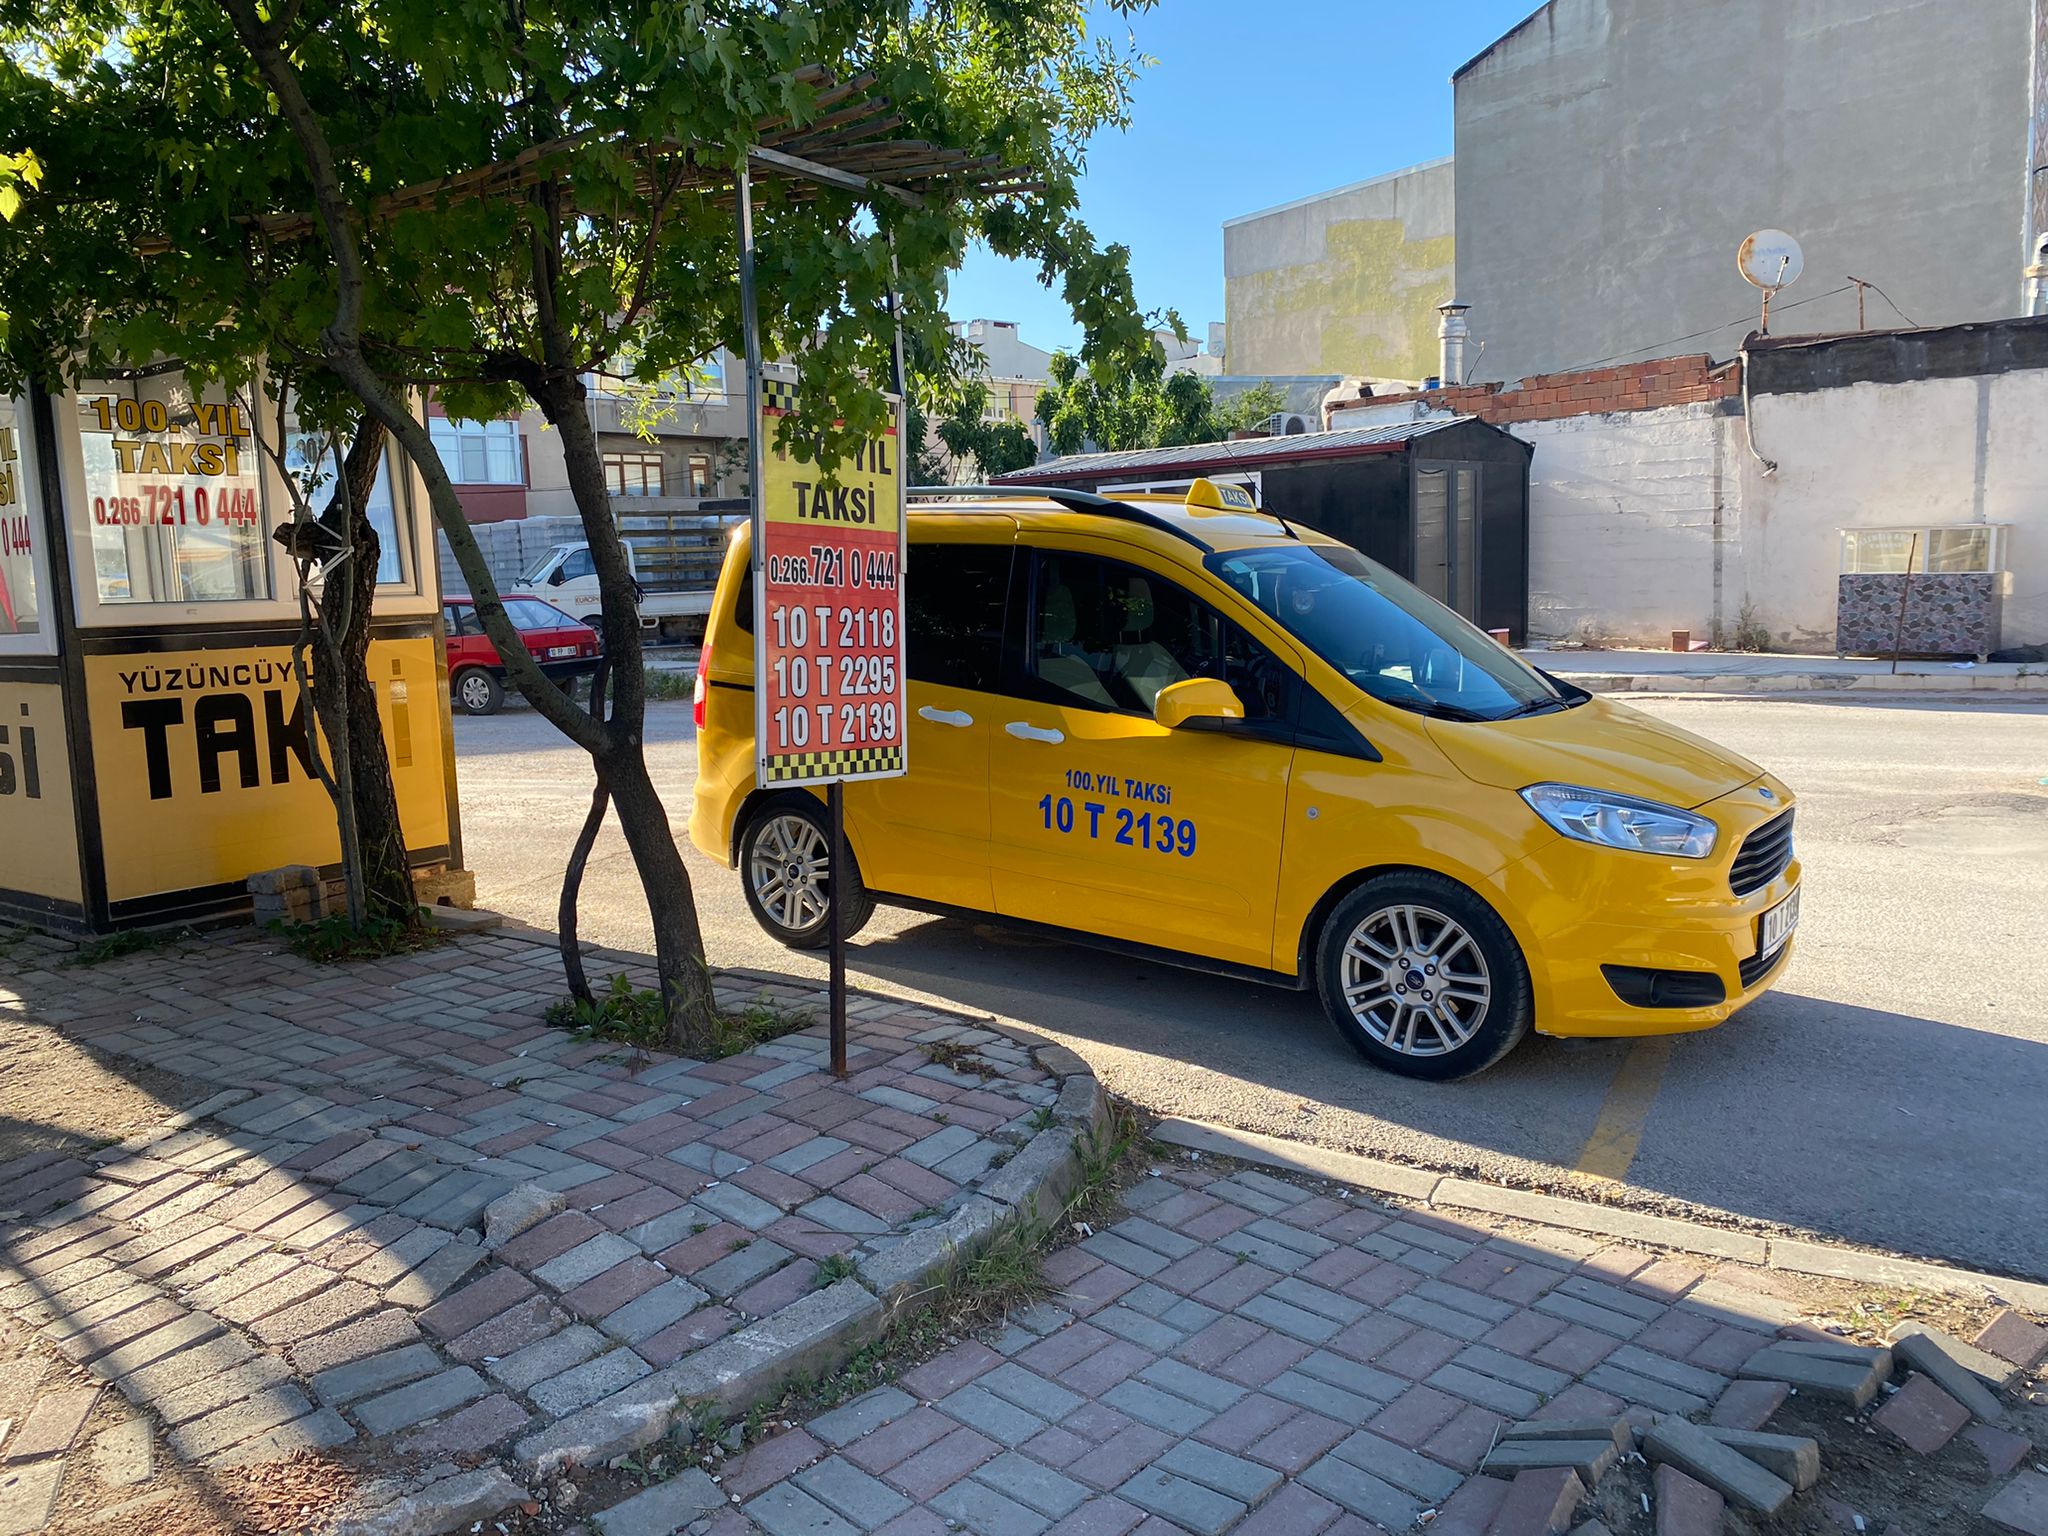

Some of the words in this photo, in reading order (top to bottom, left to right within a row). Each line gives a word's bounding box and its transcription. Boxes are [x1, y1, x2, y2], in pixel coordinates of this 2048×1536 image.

[91, 397, 180, 433] 100.
[188, 402, 251, 437] YIL
[112, 437, 239, 476] TAKSİ
[95, 496, 141, 525] 0.266
[142, 485, 186, 525] 721
[195, 487, 209, 526] 0
[217, 487, 257, 526] 444
[792, 481, 875, 524] TAKSİ
[2, 518, 10, 556] 0
[12, 515, 32, 555] 444
[851, 550, 861, 588] 0
[866, 552, 896, 590] 444
[773, 605, 808, 649] 10
[815, 606, 832, 647] T
[839, 606, 895, 648] 2118
[119, 659, 315, 694] YÜZÜNCÜYL
[773, 656, 809, 698] 10
[816, 656, 833, 696] T
[839, 655, 896, 695] 2295
[121, 659, 412, 800] TAKİ
[774, 705, 809, 747] 10
[816, 704, 834, 745] T
[840, 701, 896, 744] 2139
[1039, 794, 1074, 833] 10
[1084, 802, 1105, 839] T
[1115, 808, 1197, 858] 2139
